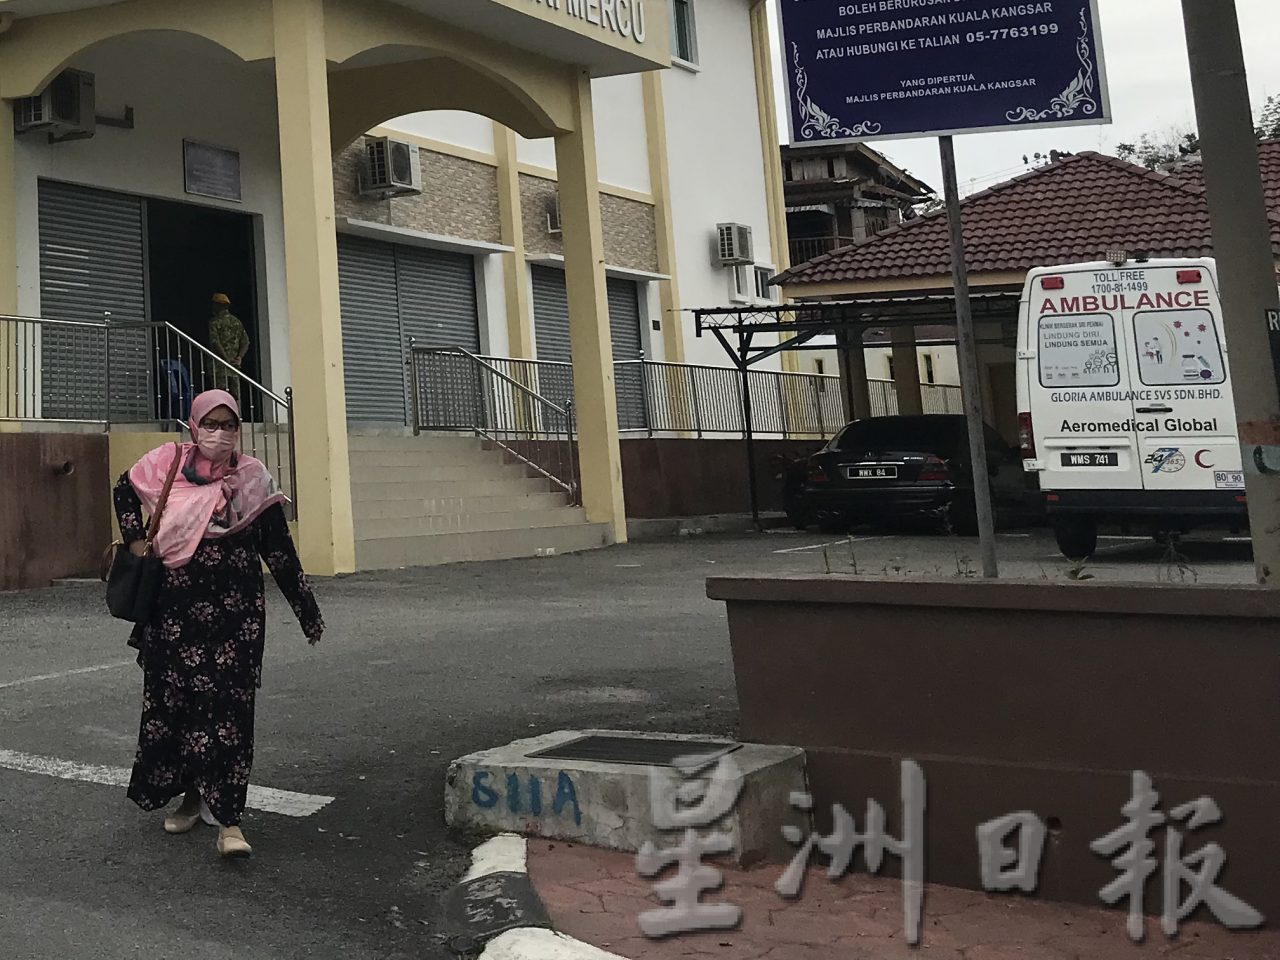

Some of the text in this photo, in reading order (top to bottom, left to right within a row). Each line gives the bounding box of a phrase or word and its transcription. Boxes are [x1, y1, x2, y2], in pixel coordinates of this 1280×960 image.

[838, 2, 877, 16] BOLEH
[816, 2, 1053, 39] MAJLIS PERBANDARAN KUALA KANGSAR
[816, 23, 1059, 60] ATAU HUBUNGI KE TALIAN 05-7763199
[900, 73, 976, 88] YANG DIPERTUA
[846, 78, 1036, 104] MAJLIS PERBANDARAN KUALA KANGSAR
[1093, 271, 1145, 283] TOLL FREE
[1091, 282, 1148, 294] 1700-81-1499
[1040, 290, 1210, 314] AMBULANCE
[1043, 331, 1081, 340] LINDUNG
[1080, 339, 1109, 347] SEMUA
[1051, 392, 1087, 402] GLORIA
[1089, 390, 1151, 401] AMBULANCE
[1154, 390, 1172, 400] SVS
[1060, 418, 1218, 433] Aeromedical Global
[1070, 454, 1109, 465] WMS 741
[1144, 453, 1164, 464] 24
[1215, 472, 1227, 482] 80
[1231, 474, 1242, 482] 90
